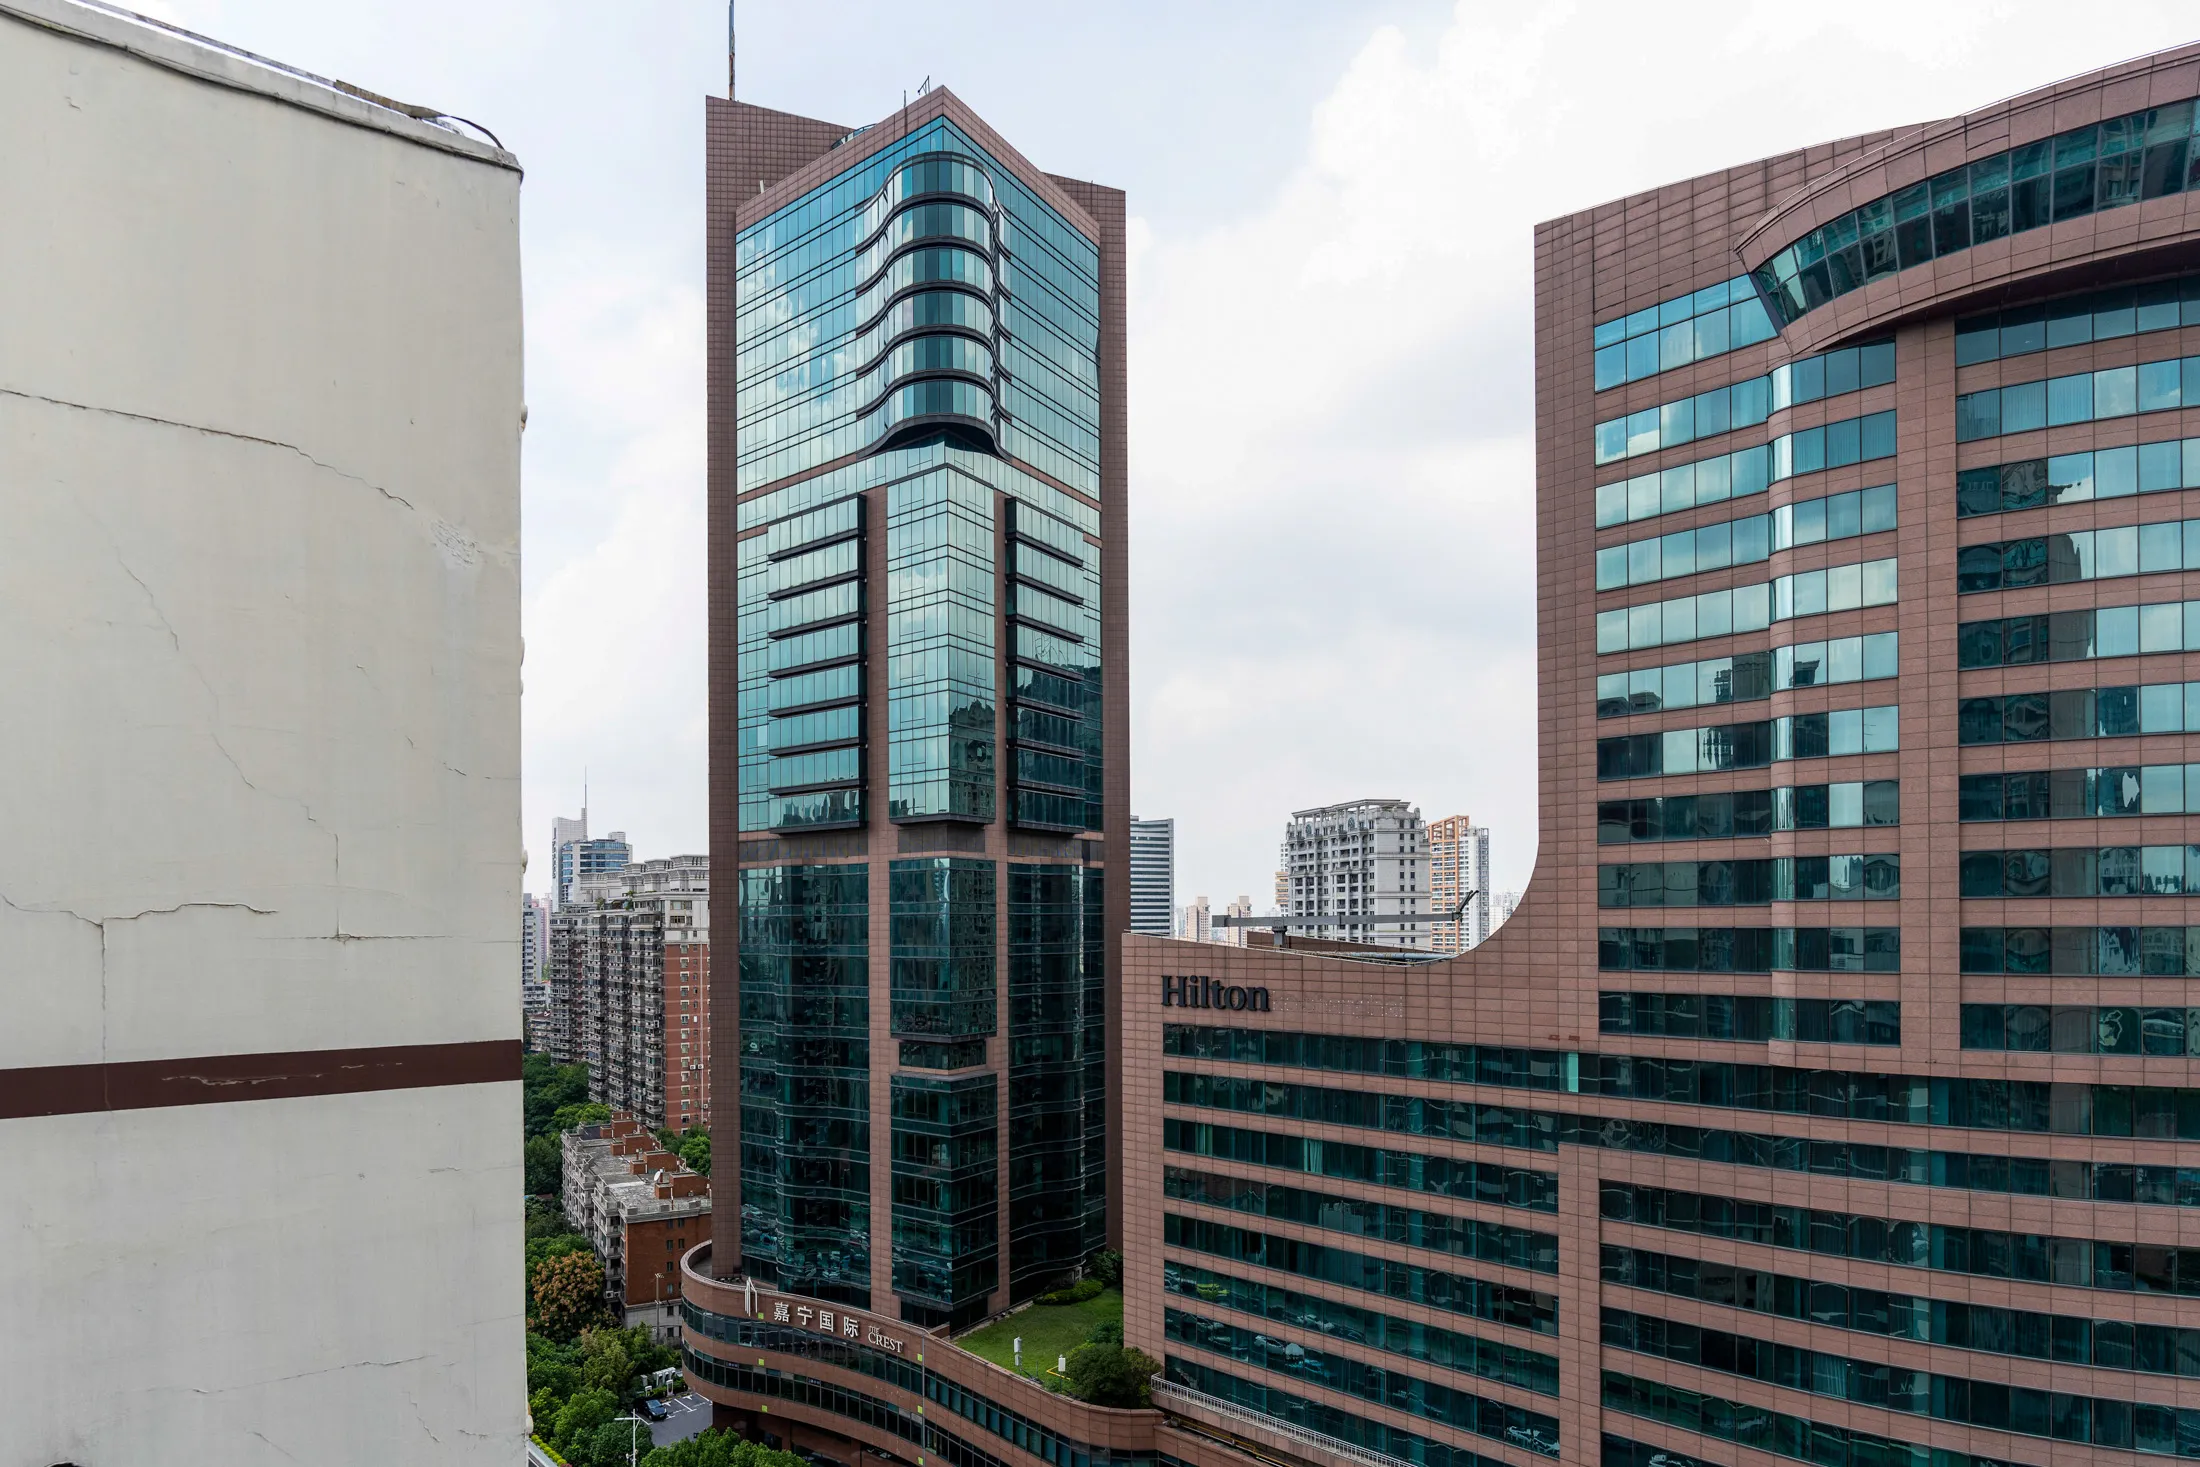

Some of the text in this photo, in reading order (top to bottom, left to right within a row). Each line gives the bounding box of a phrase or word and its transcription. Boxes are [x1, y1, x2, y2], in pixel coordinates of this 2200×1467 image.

[1161, 975, 1270, 1011] Hilton
[774, 1302, 859, 1338] 嘉宁国际
[868, 1332, 903, 1353] CREST
